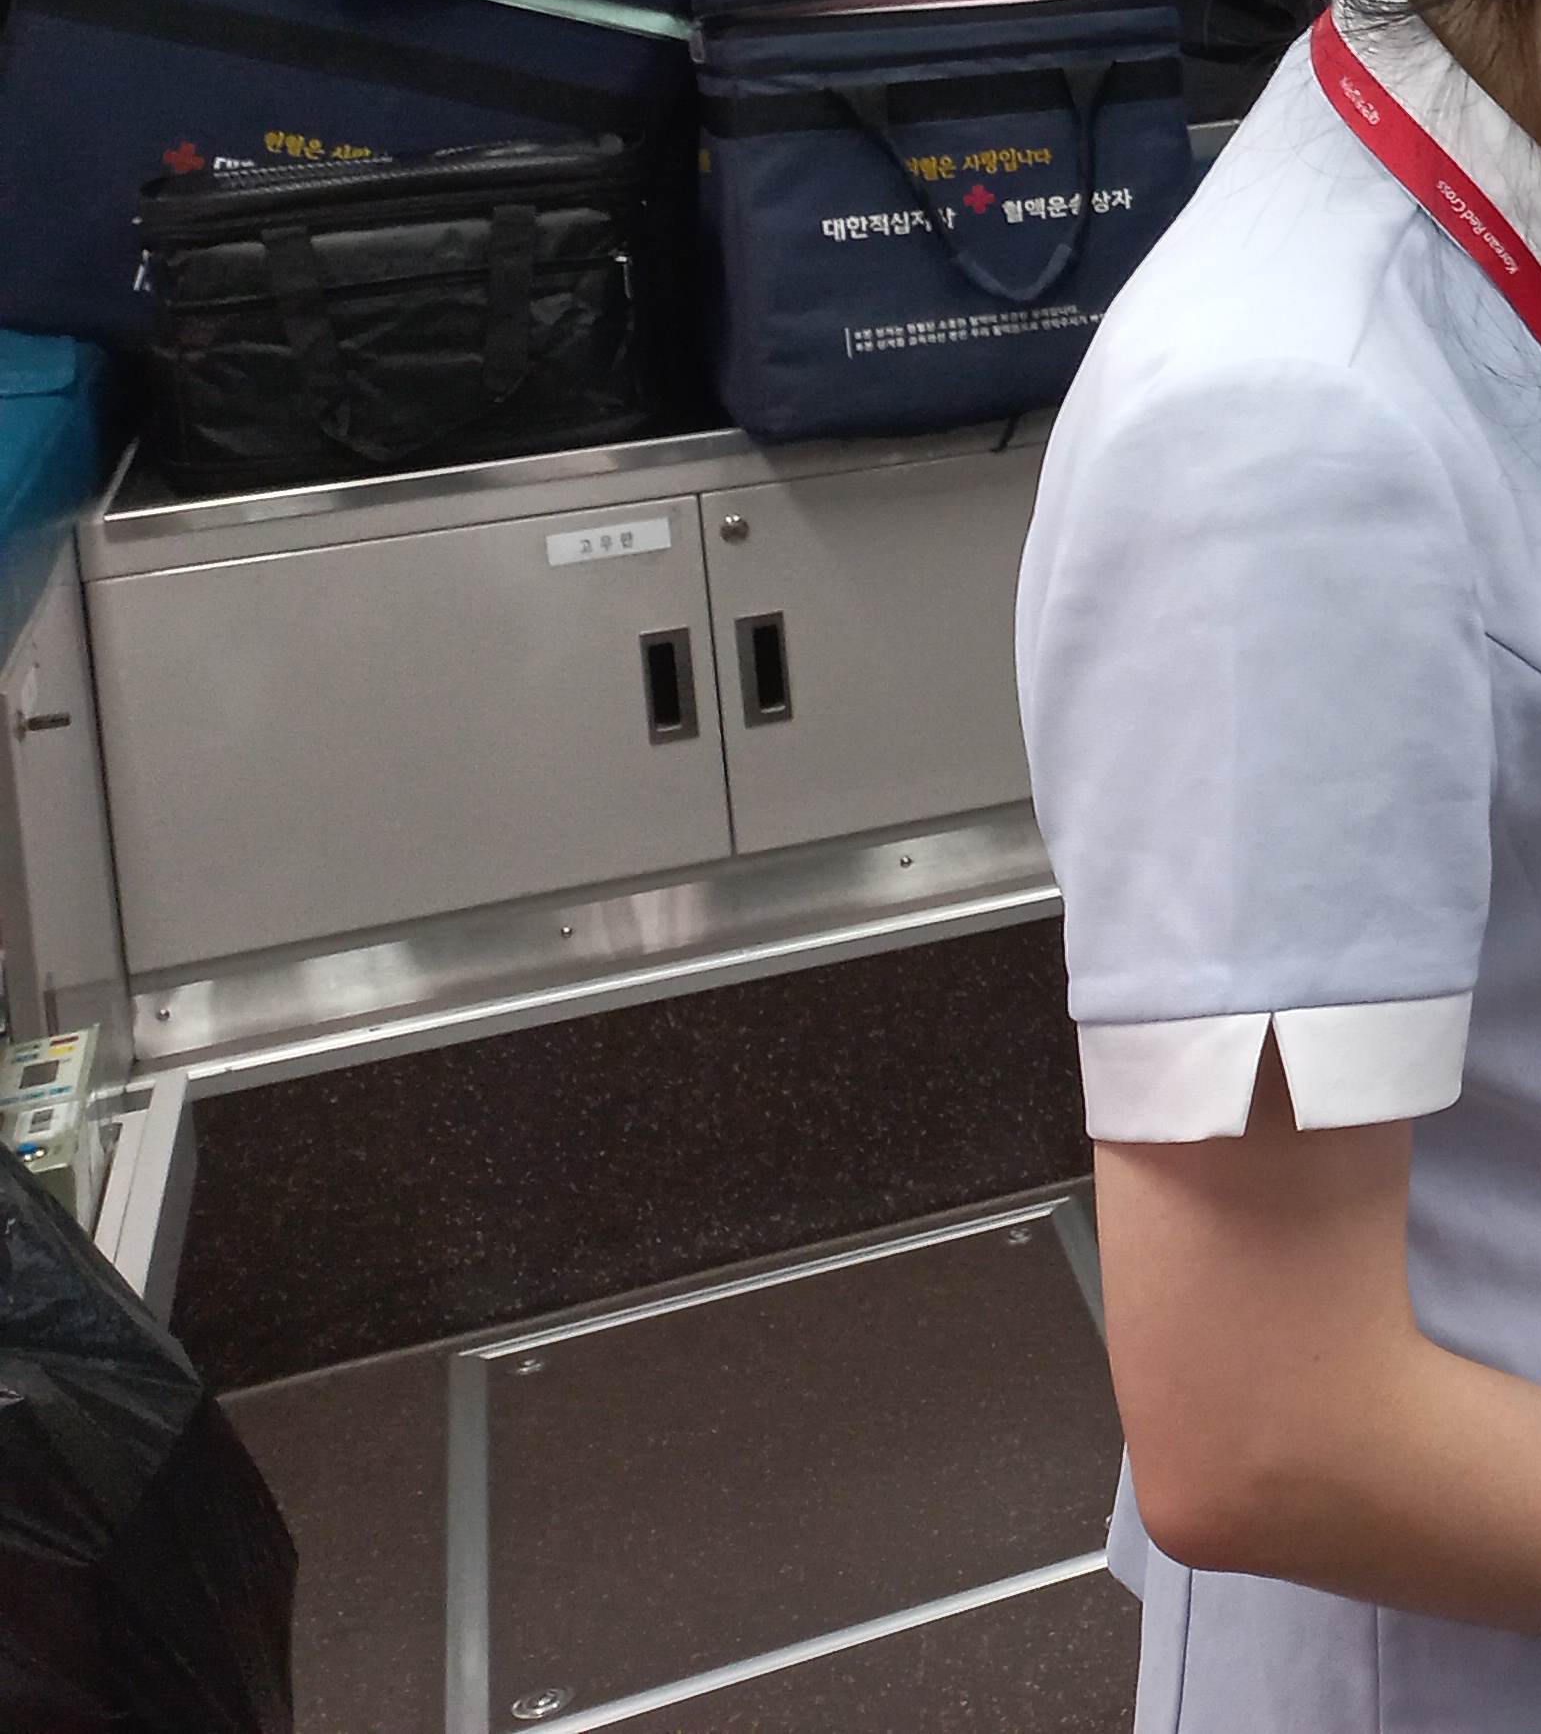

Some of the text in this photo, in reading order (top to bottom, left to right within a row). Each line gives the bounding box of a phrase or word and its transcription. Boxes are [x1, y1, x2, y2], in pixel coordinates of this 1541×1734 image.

[962, 147, 1054, 174] 사랑입니다
[1436, 179, 1520, 275] Korean Red Cross
